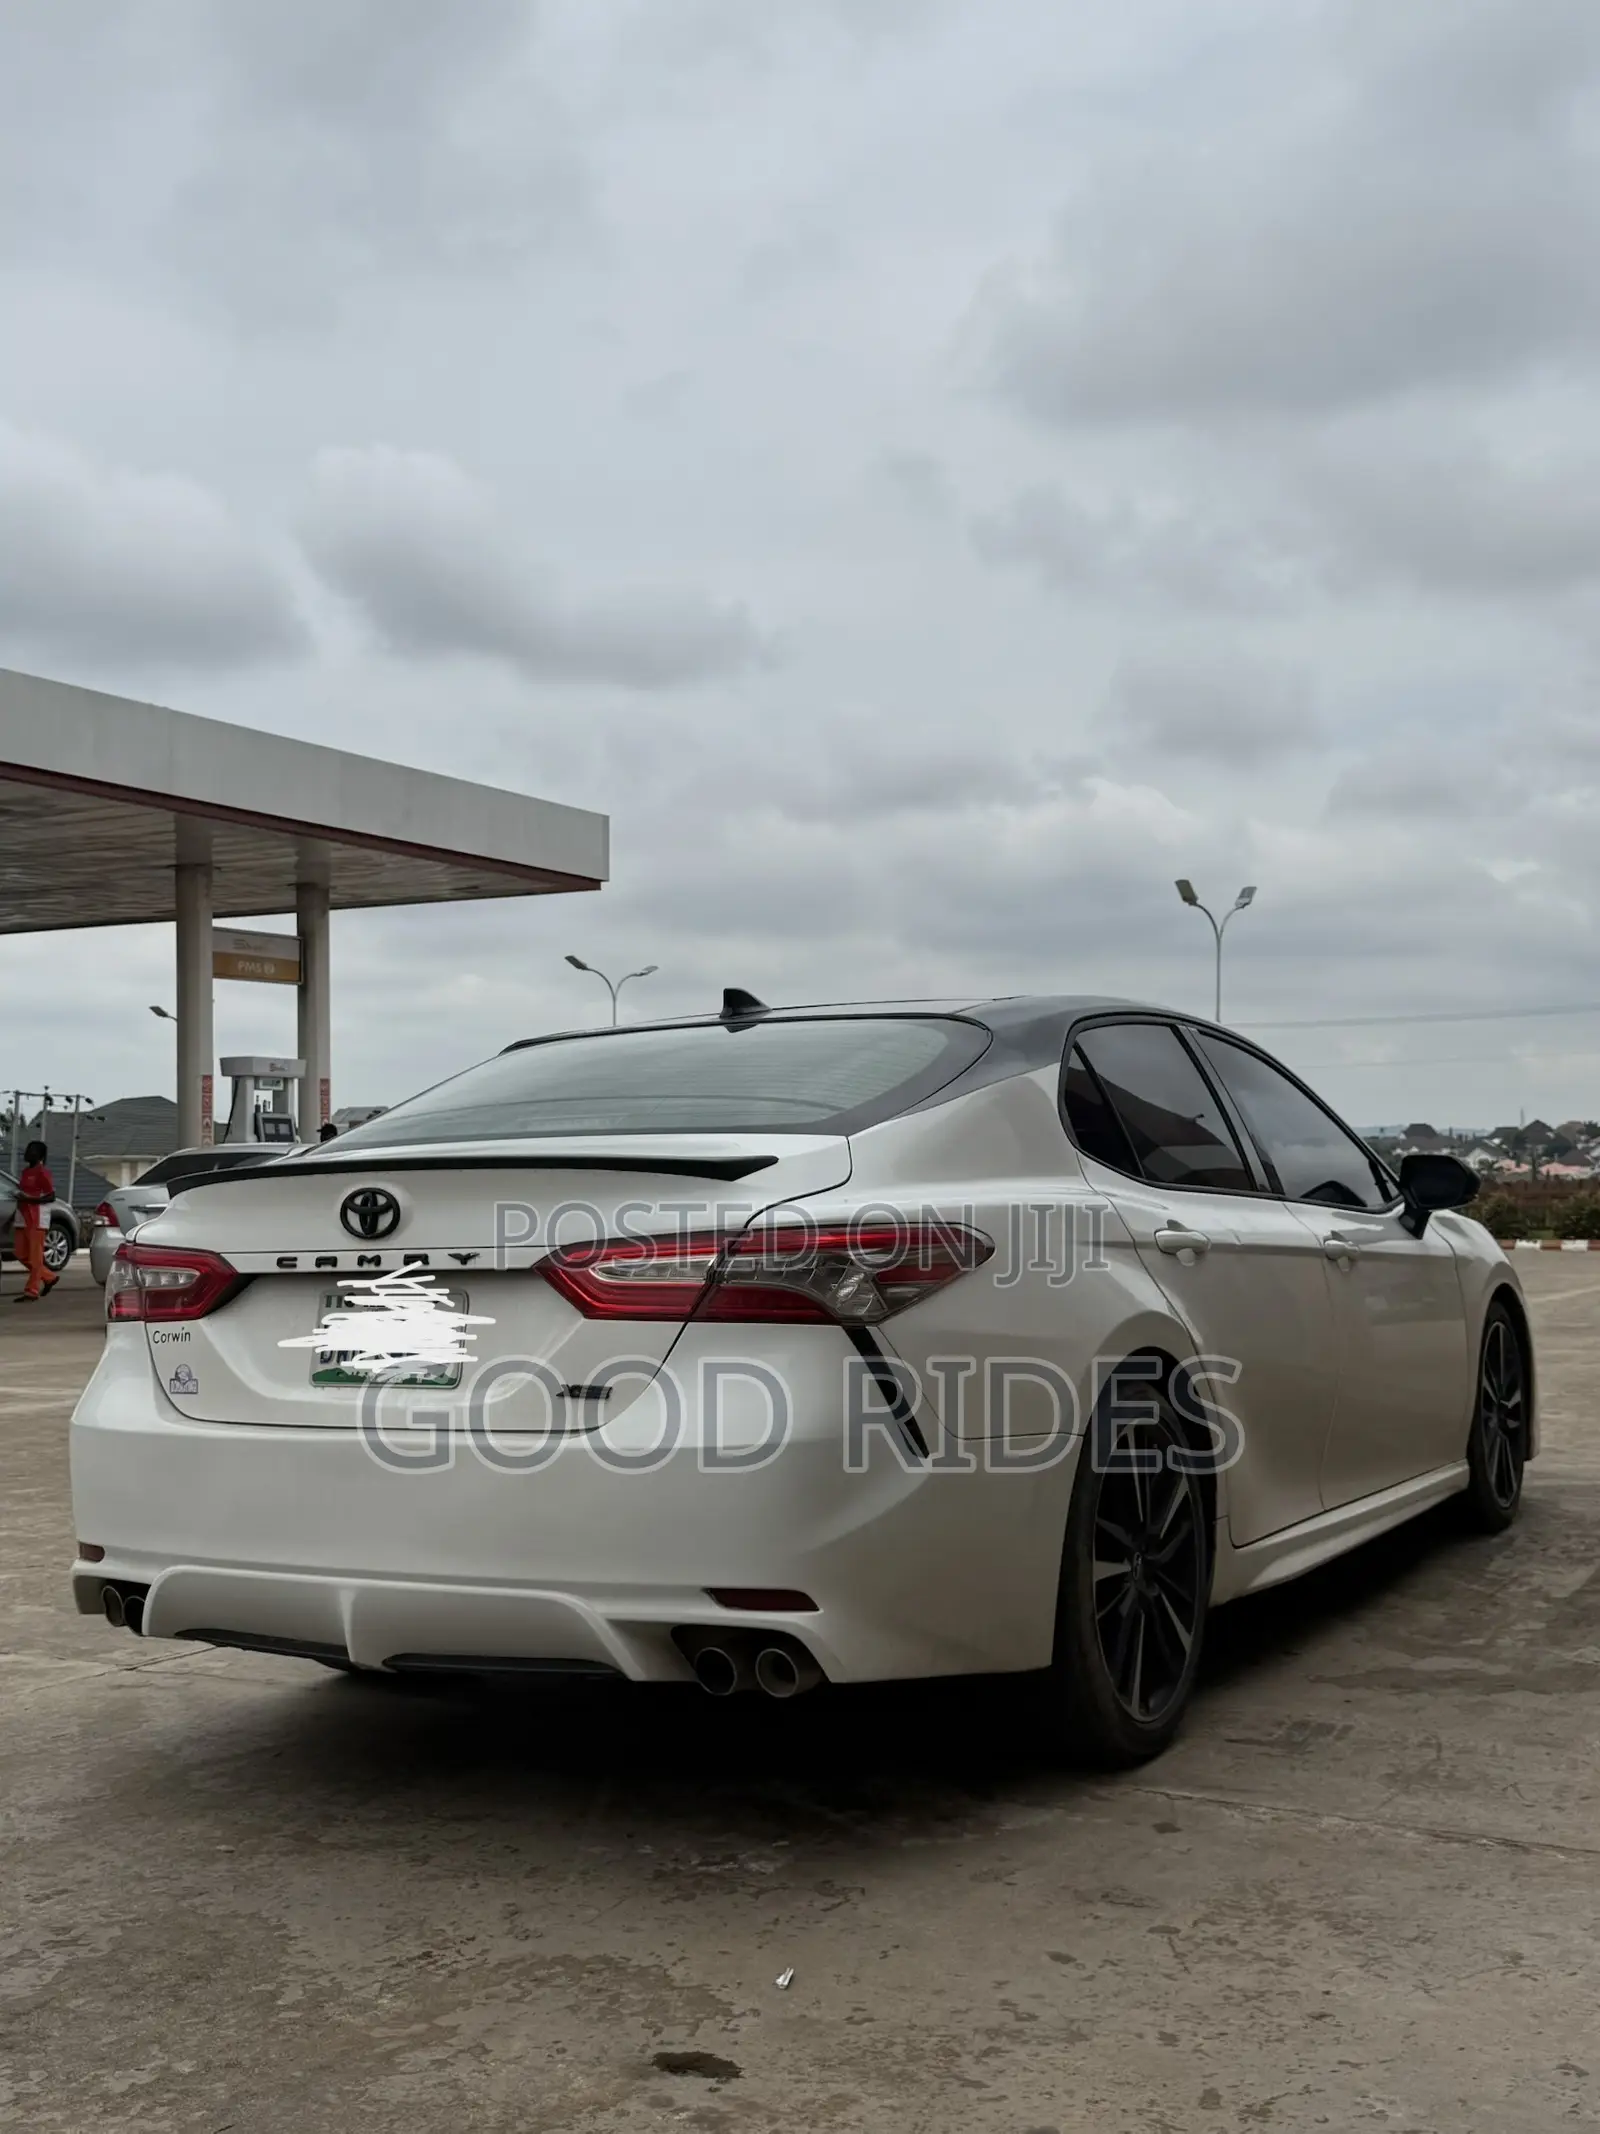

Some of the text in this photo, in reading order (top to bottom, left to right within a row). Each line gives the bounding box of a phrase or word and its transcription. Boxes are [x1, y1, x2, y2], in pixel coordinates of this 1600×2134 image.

[238, 960, 262, 974] PMS
[276, 1252, 480, 1269] CAMRY
[152, 1326, 191, 1344] Corwin
